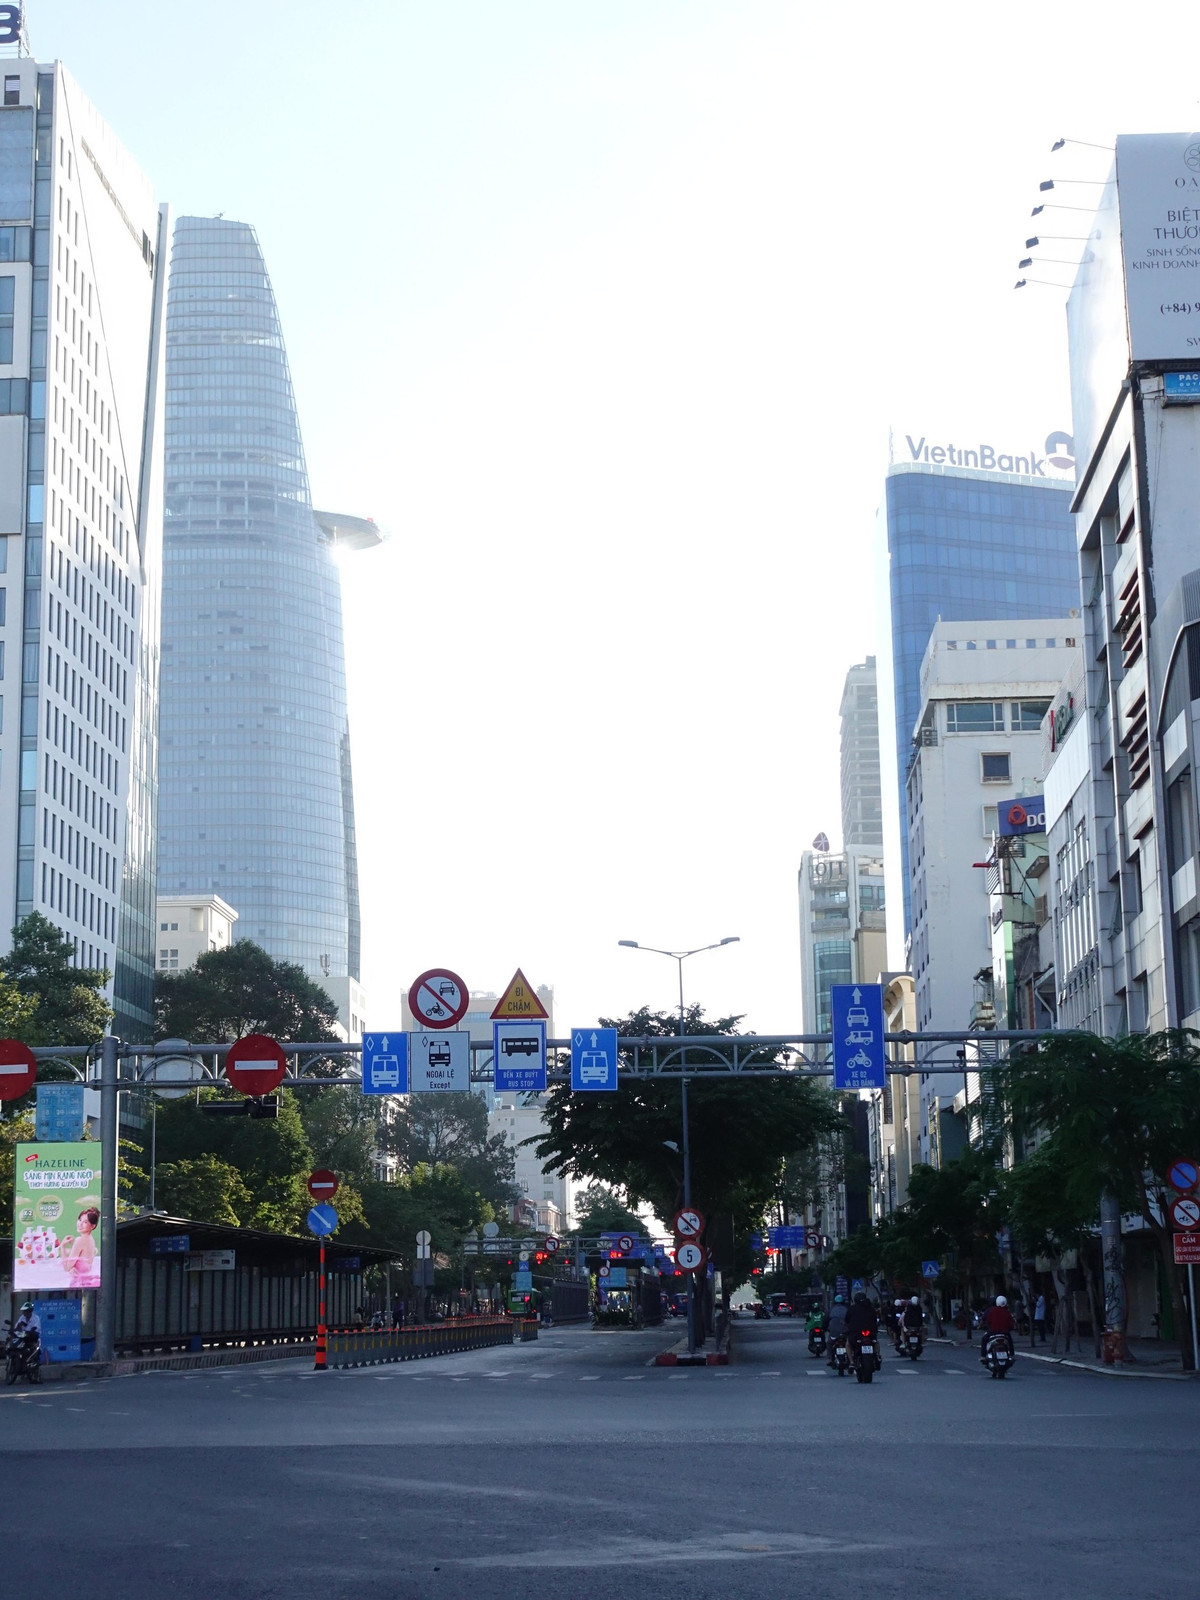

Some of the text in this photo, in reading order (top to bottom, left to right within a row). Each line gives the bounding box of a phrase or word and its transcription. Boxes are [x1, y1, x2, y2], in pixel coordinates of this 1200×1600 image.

[1168, 206, 1200, 223] BIỆT
[1153, 225, 1200, 240] THƯƠ
[1146, 248, 1173, 257] SINH
[1132, 261, 1160, 270] KINH
[1160, 302, 1192, 315] (+84)
[905, 435, 1045, 477] VietinBank
[515, 987, 524, 997] ĐI
[507, 999, 531, 1013] CHẬM
[426, 1068, 455, 1080] NGOẠI LỆ
[525, 1070, 538, 1079] BUÝT
[429, 1081, 451, 1090] Except
[35, 1159, 85, 1168] HAZELINE
[1181, 1234, 1196, 1243] CẤM
[686, 1249, 693, 1263] 5
